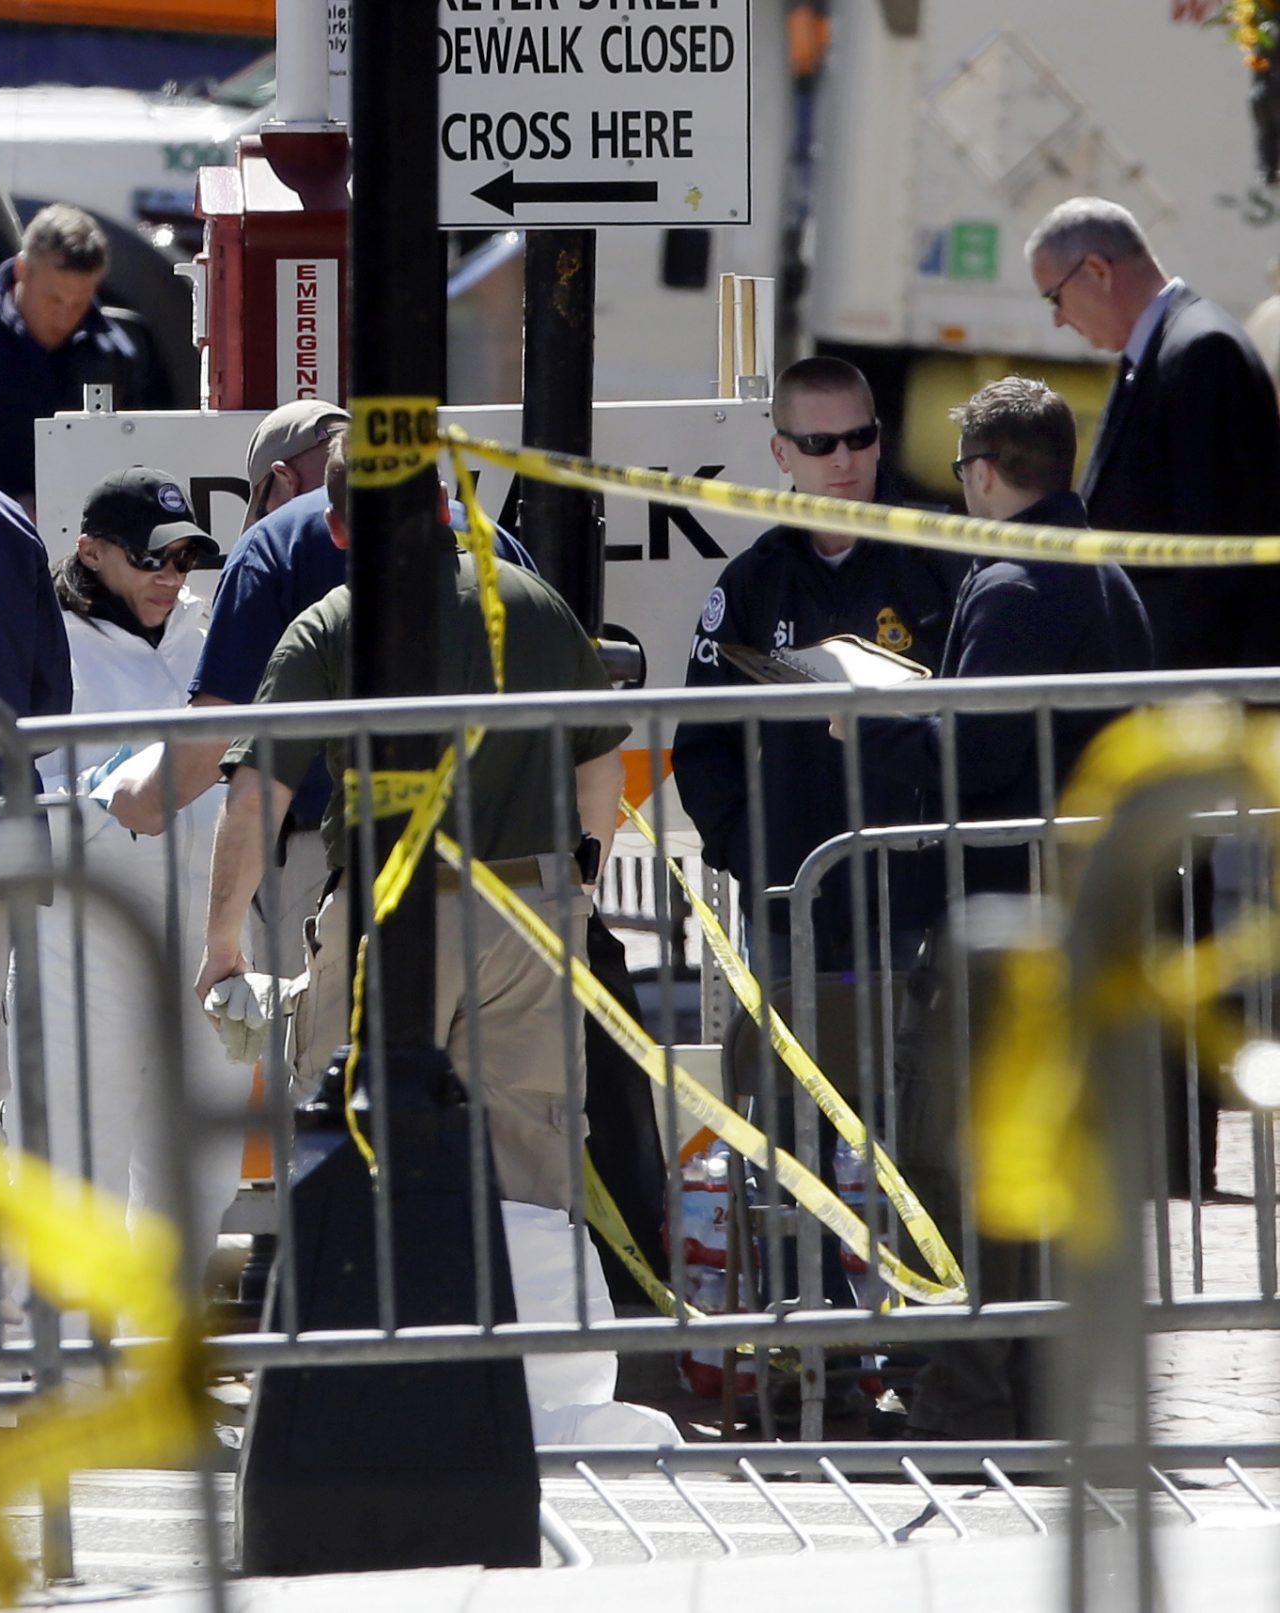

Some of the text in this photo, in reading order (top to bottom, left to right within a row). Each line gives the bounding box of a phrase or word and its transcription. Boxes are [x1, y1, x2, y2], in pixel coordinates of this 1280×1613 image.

[601, 25, 734, 73] CLOSED
[441, 110, 693, 161] CROSS HERE
